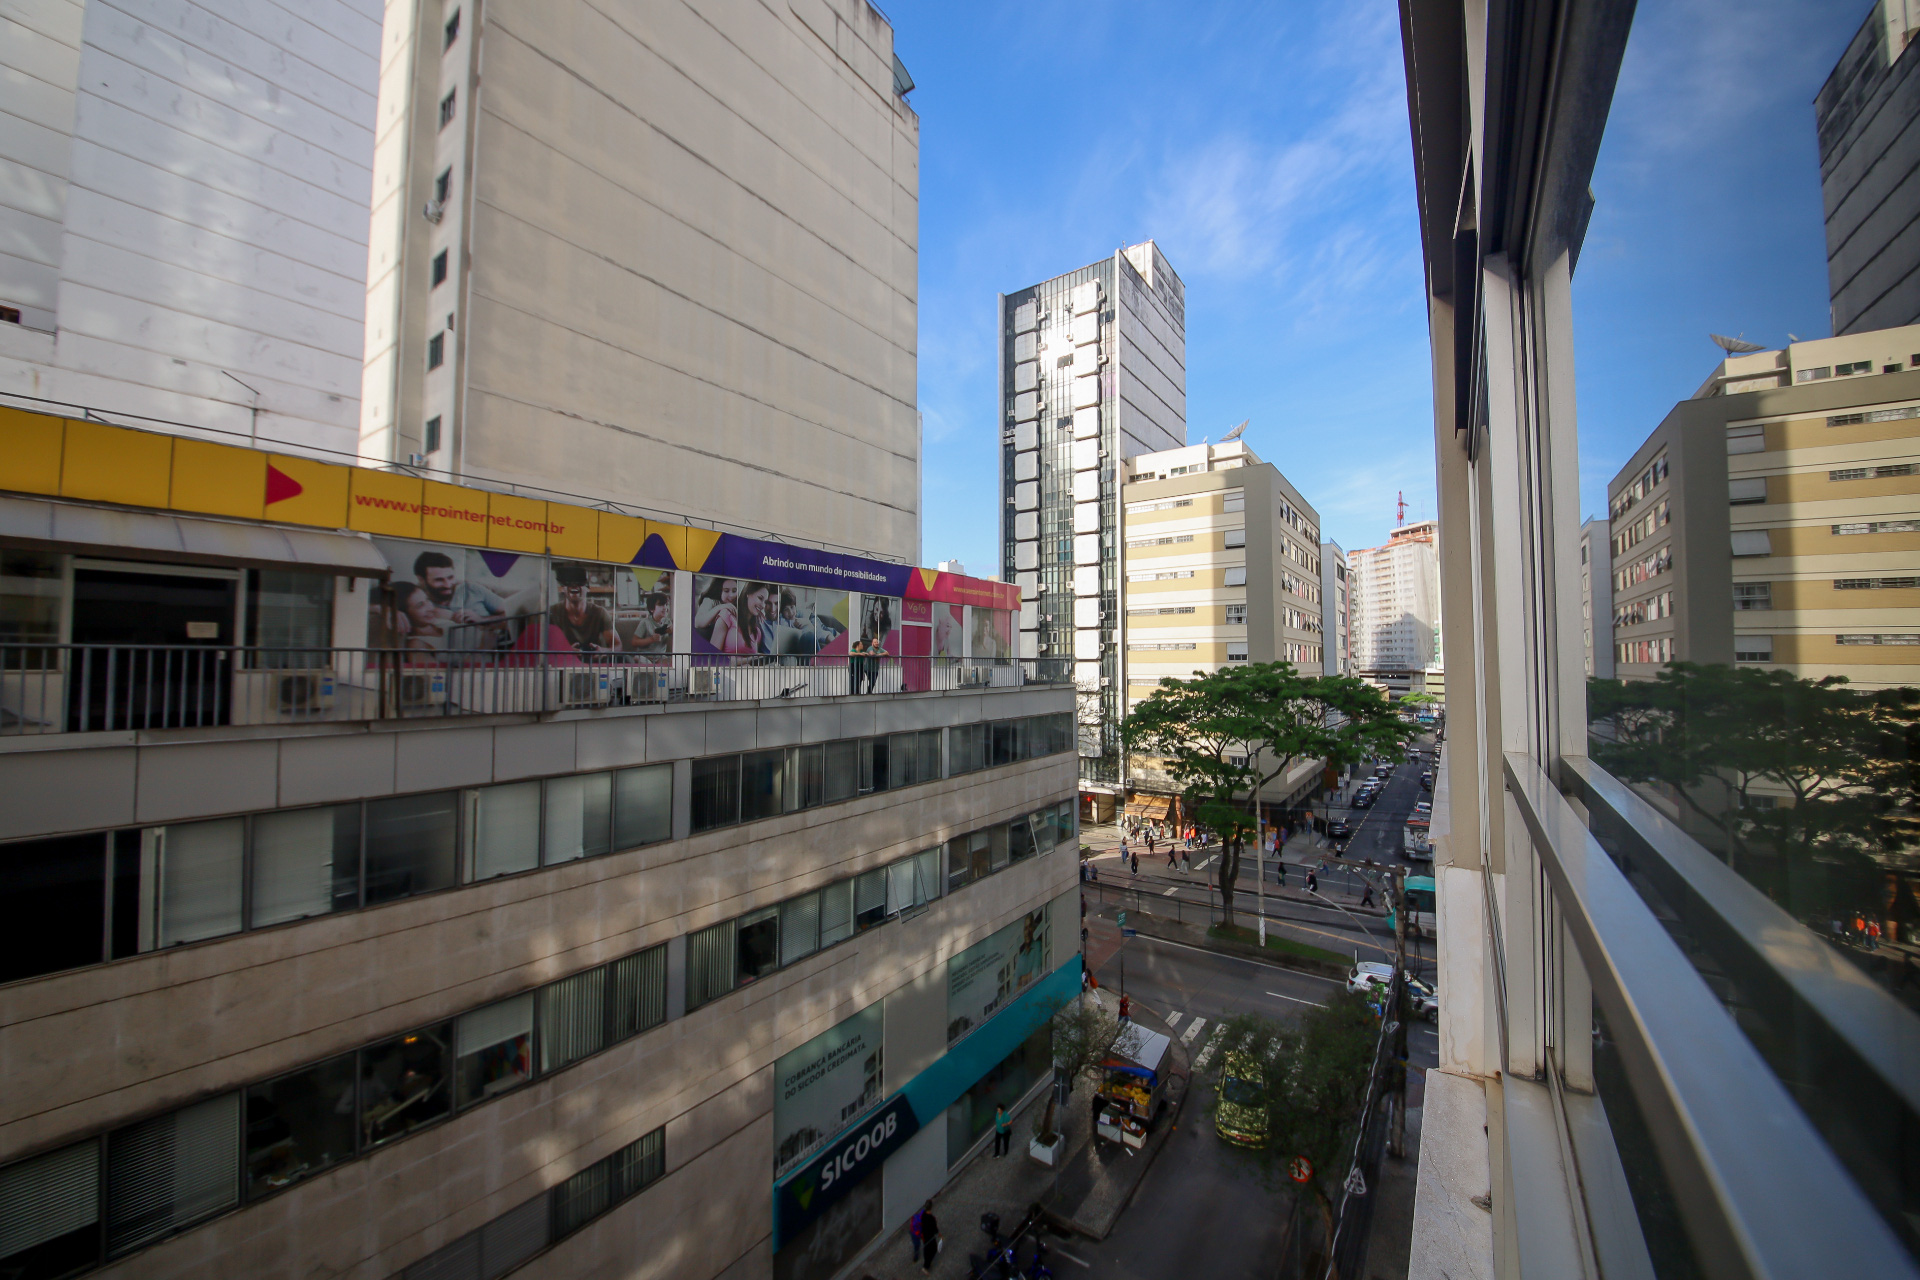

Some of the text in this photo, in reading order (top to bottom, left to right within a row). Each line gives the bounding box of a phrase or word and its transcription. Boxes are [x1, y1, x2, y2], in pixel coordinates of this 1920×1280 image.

[355, 494, 565, 535] www.verointernet.com.br
[762, 555, 887, 583] Abrindo um mundo de possibilidades
[784, 1058, 827, 1088] COBRANÇA
[784, 1087, 797, 1101] DO
[797, 1069, 826, 1092] SICOOB
[821, 1111, 897, 1191] SICOOB
